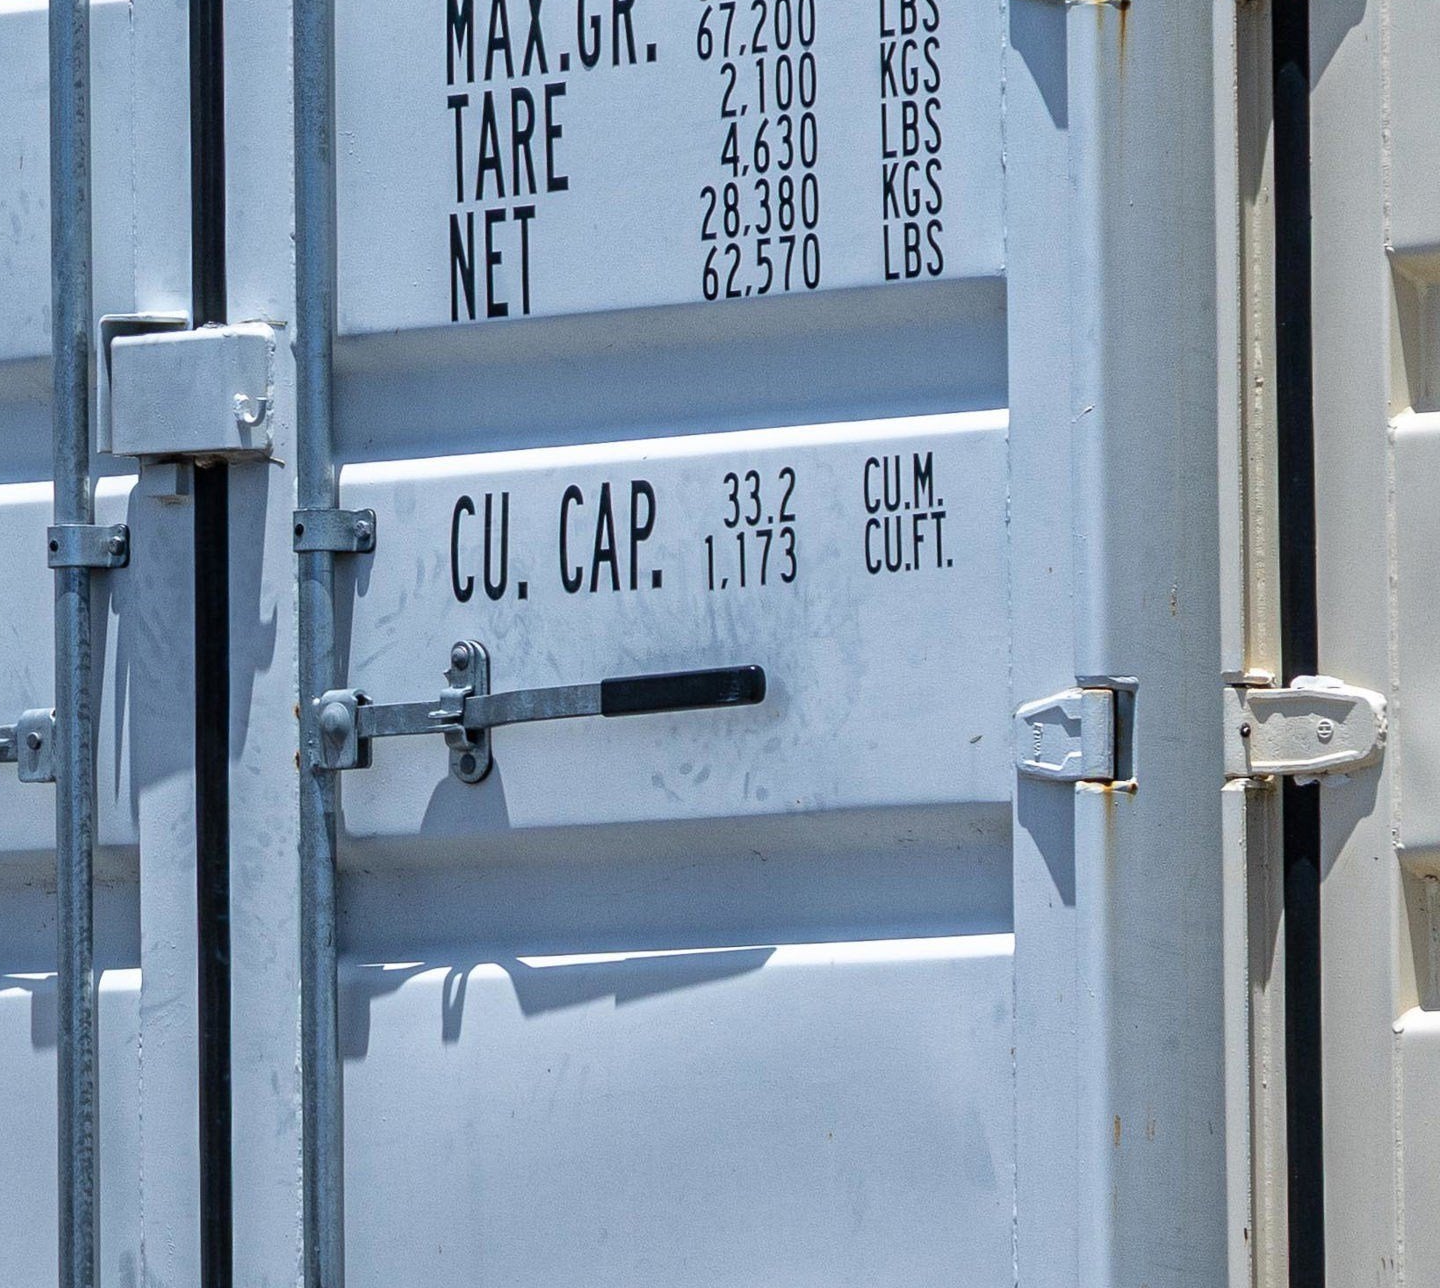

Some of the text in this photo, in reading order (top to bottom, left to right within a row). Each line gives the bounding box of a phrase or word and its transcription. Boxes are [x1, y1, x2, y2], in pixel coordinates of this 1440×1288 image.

[447, 37, 941, 203] TARE 2,100 KGS
[720, 98, 941, 178] 4,630 LBS
[449, 159, 942, 322] NET 28,380 KGS
[702, 219, 944, 300] 62,570 LBS
[451, 452, 944, 603] CU. CAP. 33.2 CU.M.
[705, 511, 953, 590] 1,173 CU.FT.
